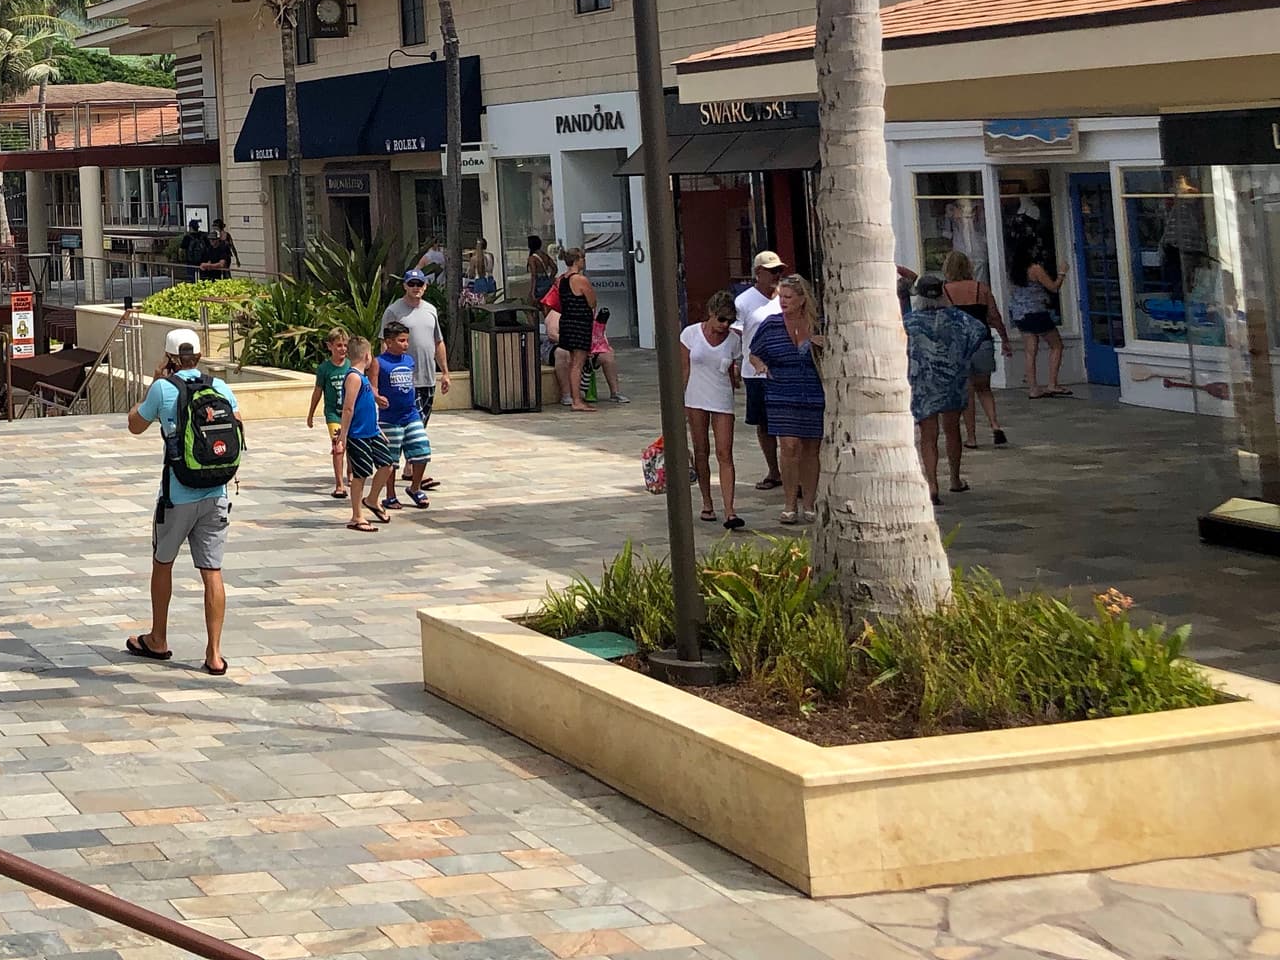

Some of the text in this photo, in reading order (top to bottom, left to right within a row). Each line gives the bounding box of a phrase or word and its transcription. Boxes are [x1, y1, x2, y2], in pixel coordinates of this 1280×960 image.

[393, 138, 418, 151] ROLEX
[256, 149, 274, 159] ROLEX
[462, 157, 484, 166] DORA
